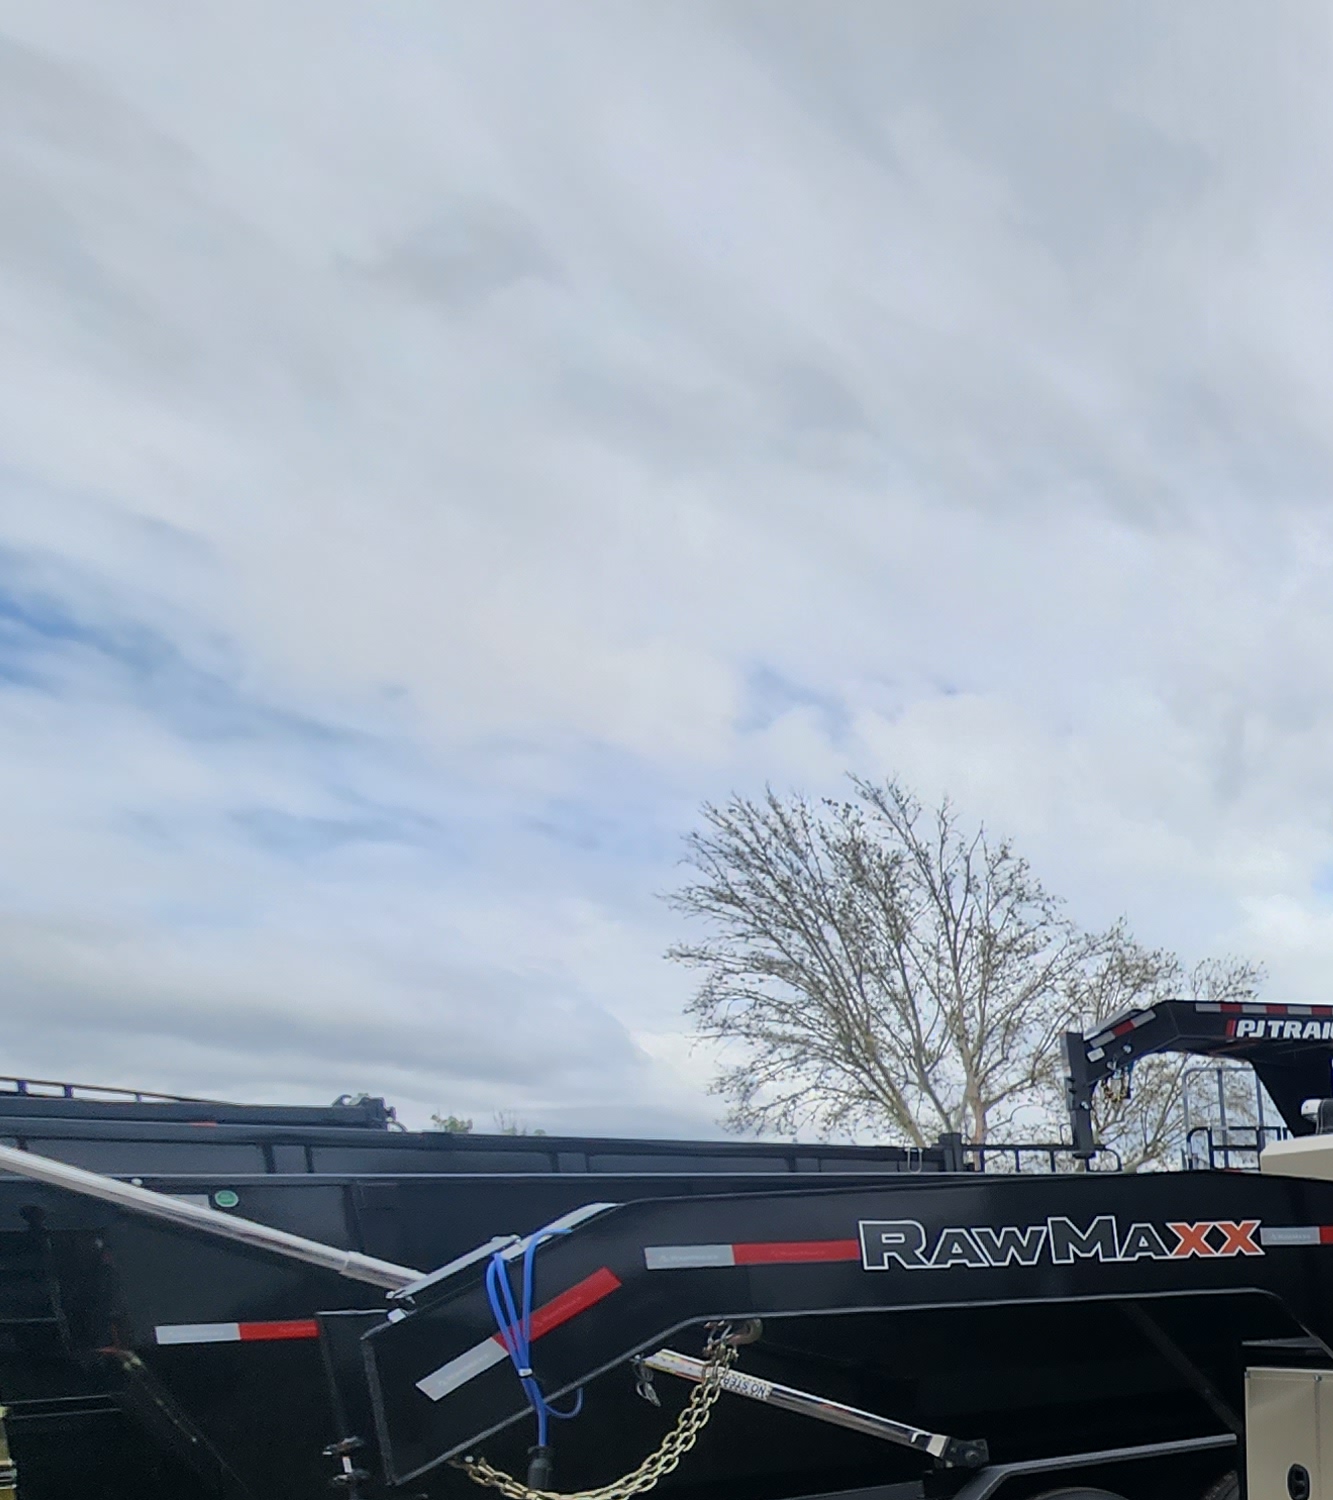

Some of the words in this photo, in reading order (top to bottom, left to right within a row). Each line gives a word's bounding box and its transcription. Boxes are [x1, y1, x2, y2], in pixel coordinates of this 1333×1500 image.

[1236, 1019, 1266, 1038] PJ
[723, 1375, 749, 1391] STEP
[751, 1384, 767, 1397] NO
